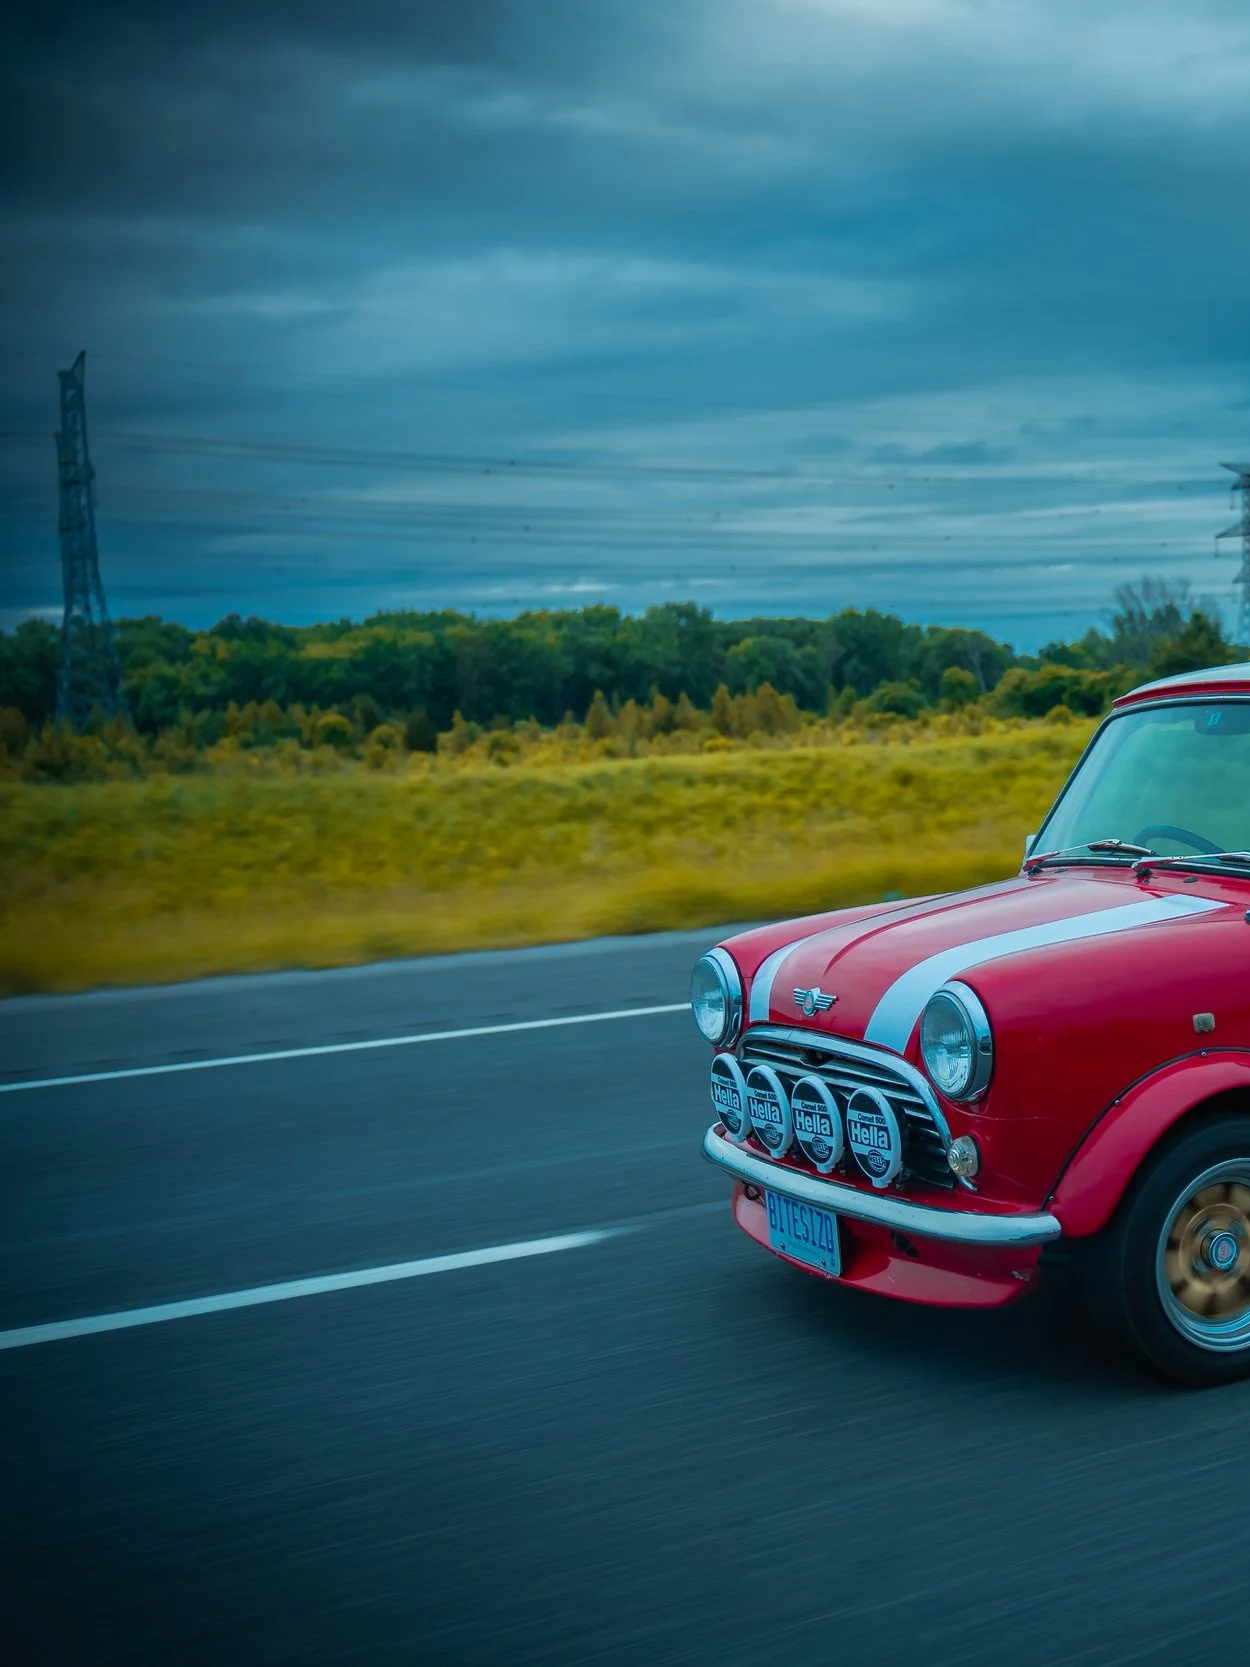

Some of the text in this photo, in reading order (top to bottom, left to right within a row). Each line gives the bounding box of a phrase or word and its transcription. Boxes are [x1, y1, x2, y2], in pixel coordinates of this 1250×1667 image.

[714, 1083, 740, 1109] Hella
[801, 1101, 828, 1113] Comet 500
[750, 1097, 780, 1122] Hella
[857, 1112, 886, 1125] Comet 500
[795, 1110, 831, 1136] Hella
[851, 1121, 889, 1148] Hella
[767, 1191, 835, 1254] BITESIZD
